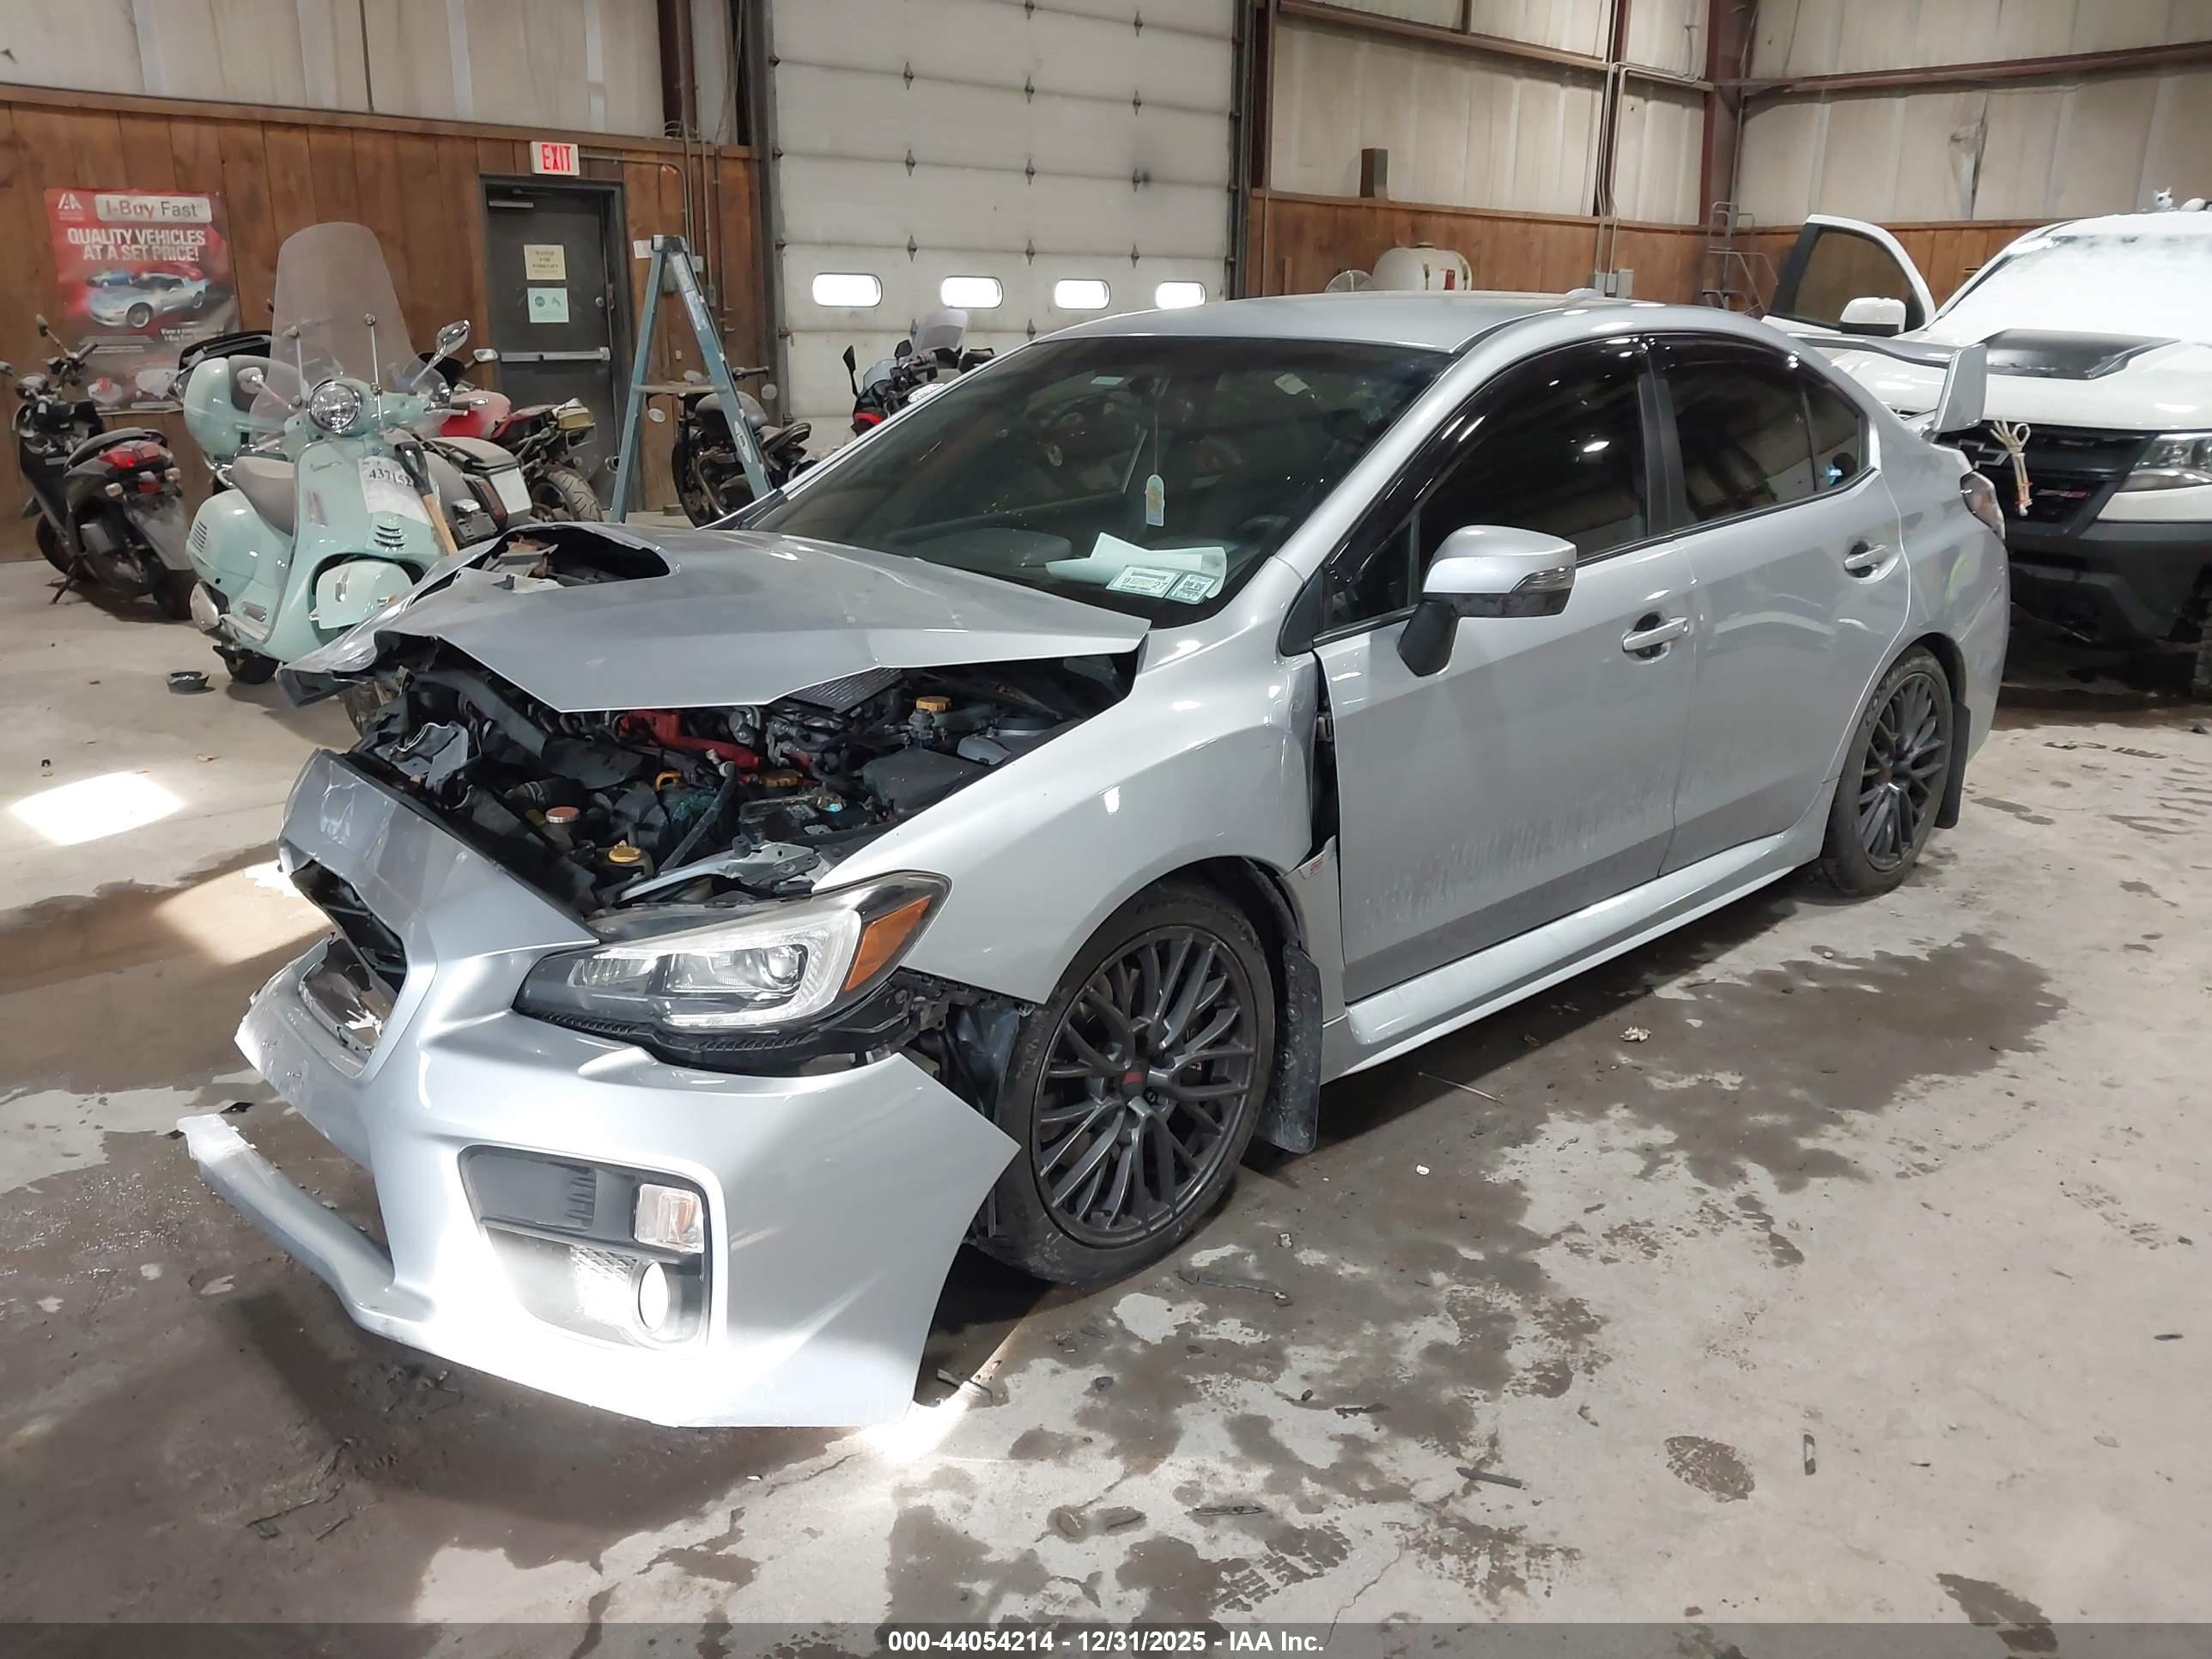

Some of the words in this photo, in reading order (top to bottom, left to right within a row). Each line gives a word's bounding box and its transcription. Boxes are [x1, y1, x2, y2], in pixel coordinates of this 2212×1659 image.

[541, 143, 571, 172] EXIT
[106, 198, 155, 216] I-Buy
[161, 200, 197, 217] Fast
[68, 228, 134, 245] QUALITY
[134, 229, 206, 246] VEHICLES
[82, 245, 102, 260] AT
[106, 246, 119, 261] A
[122, 246, 149, 261] SET
[152, 246, 199, 262] PRICE!
[368, 468, 413, 488] 437152
[1152, 581, 1169, 590] 27
